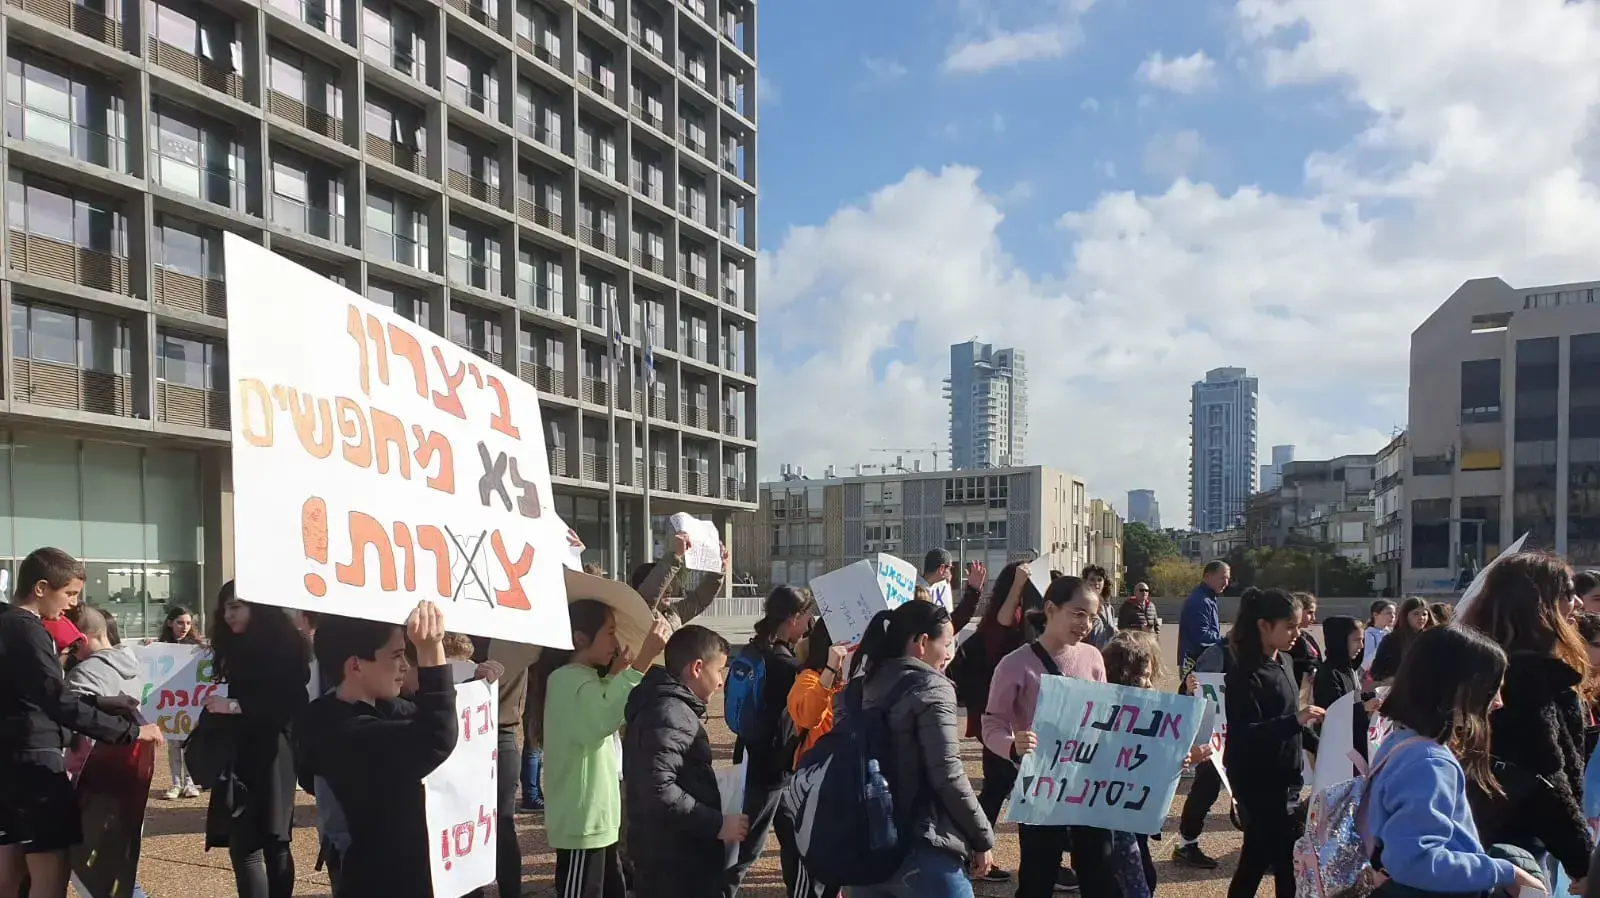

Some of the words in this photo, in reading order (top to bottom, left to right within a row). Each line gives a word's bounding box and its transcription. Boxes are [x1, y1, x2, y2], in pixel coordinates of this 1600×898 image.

[347, 304, 521, 440] ביצרון
[238, 378, 455, 494] מחפשים
[477, 440, 541, 519] לא
[1080, 701, 1182, 740] אנחנו
[1050, 739, 1099, 770] שפן
[1115, 744, 1148, 771] לא
